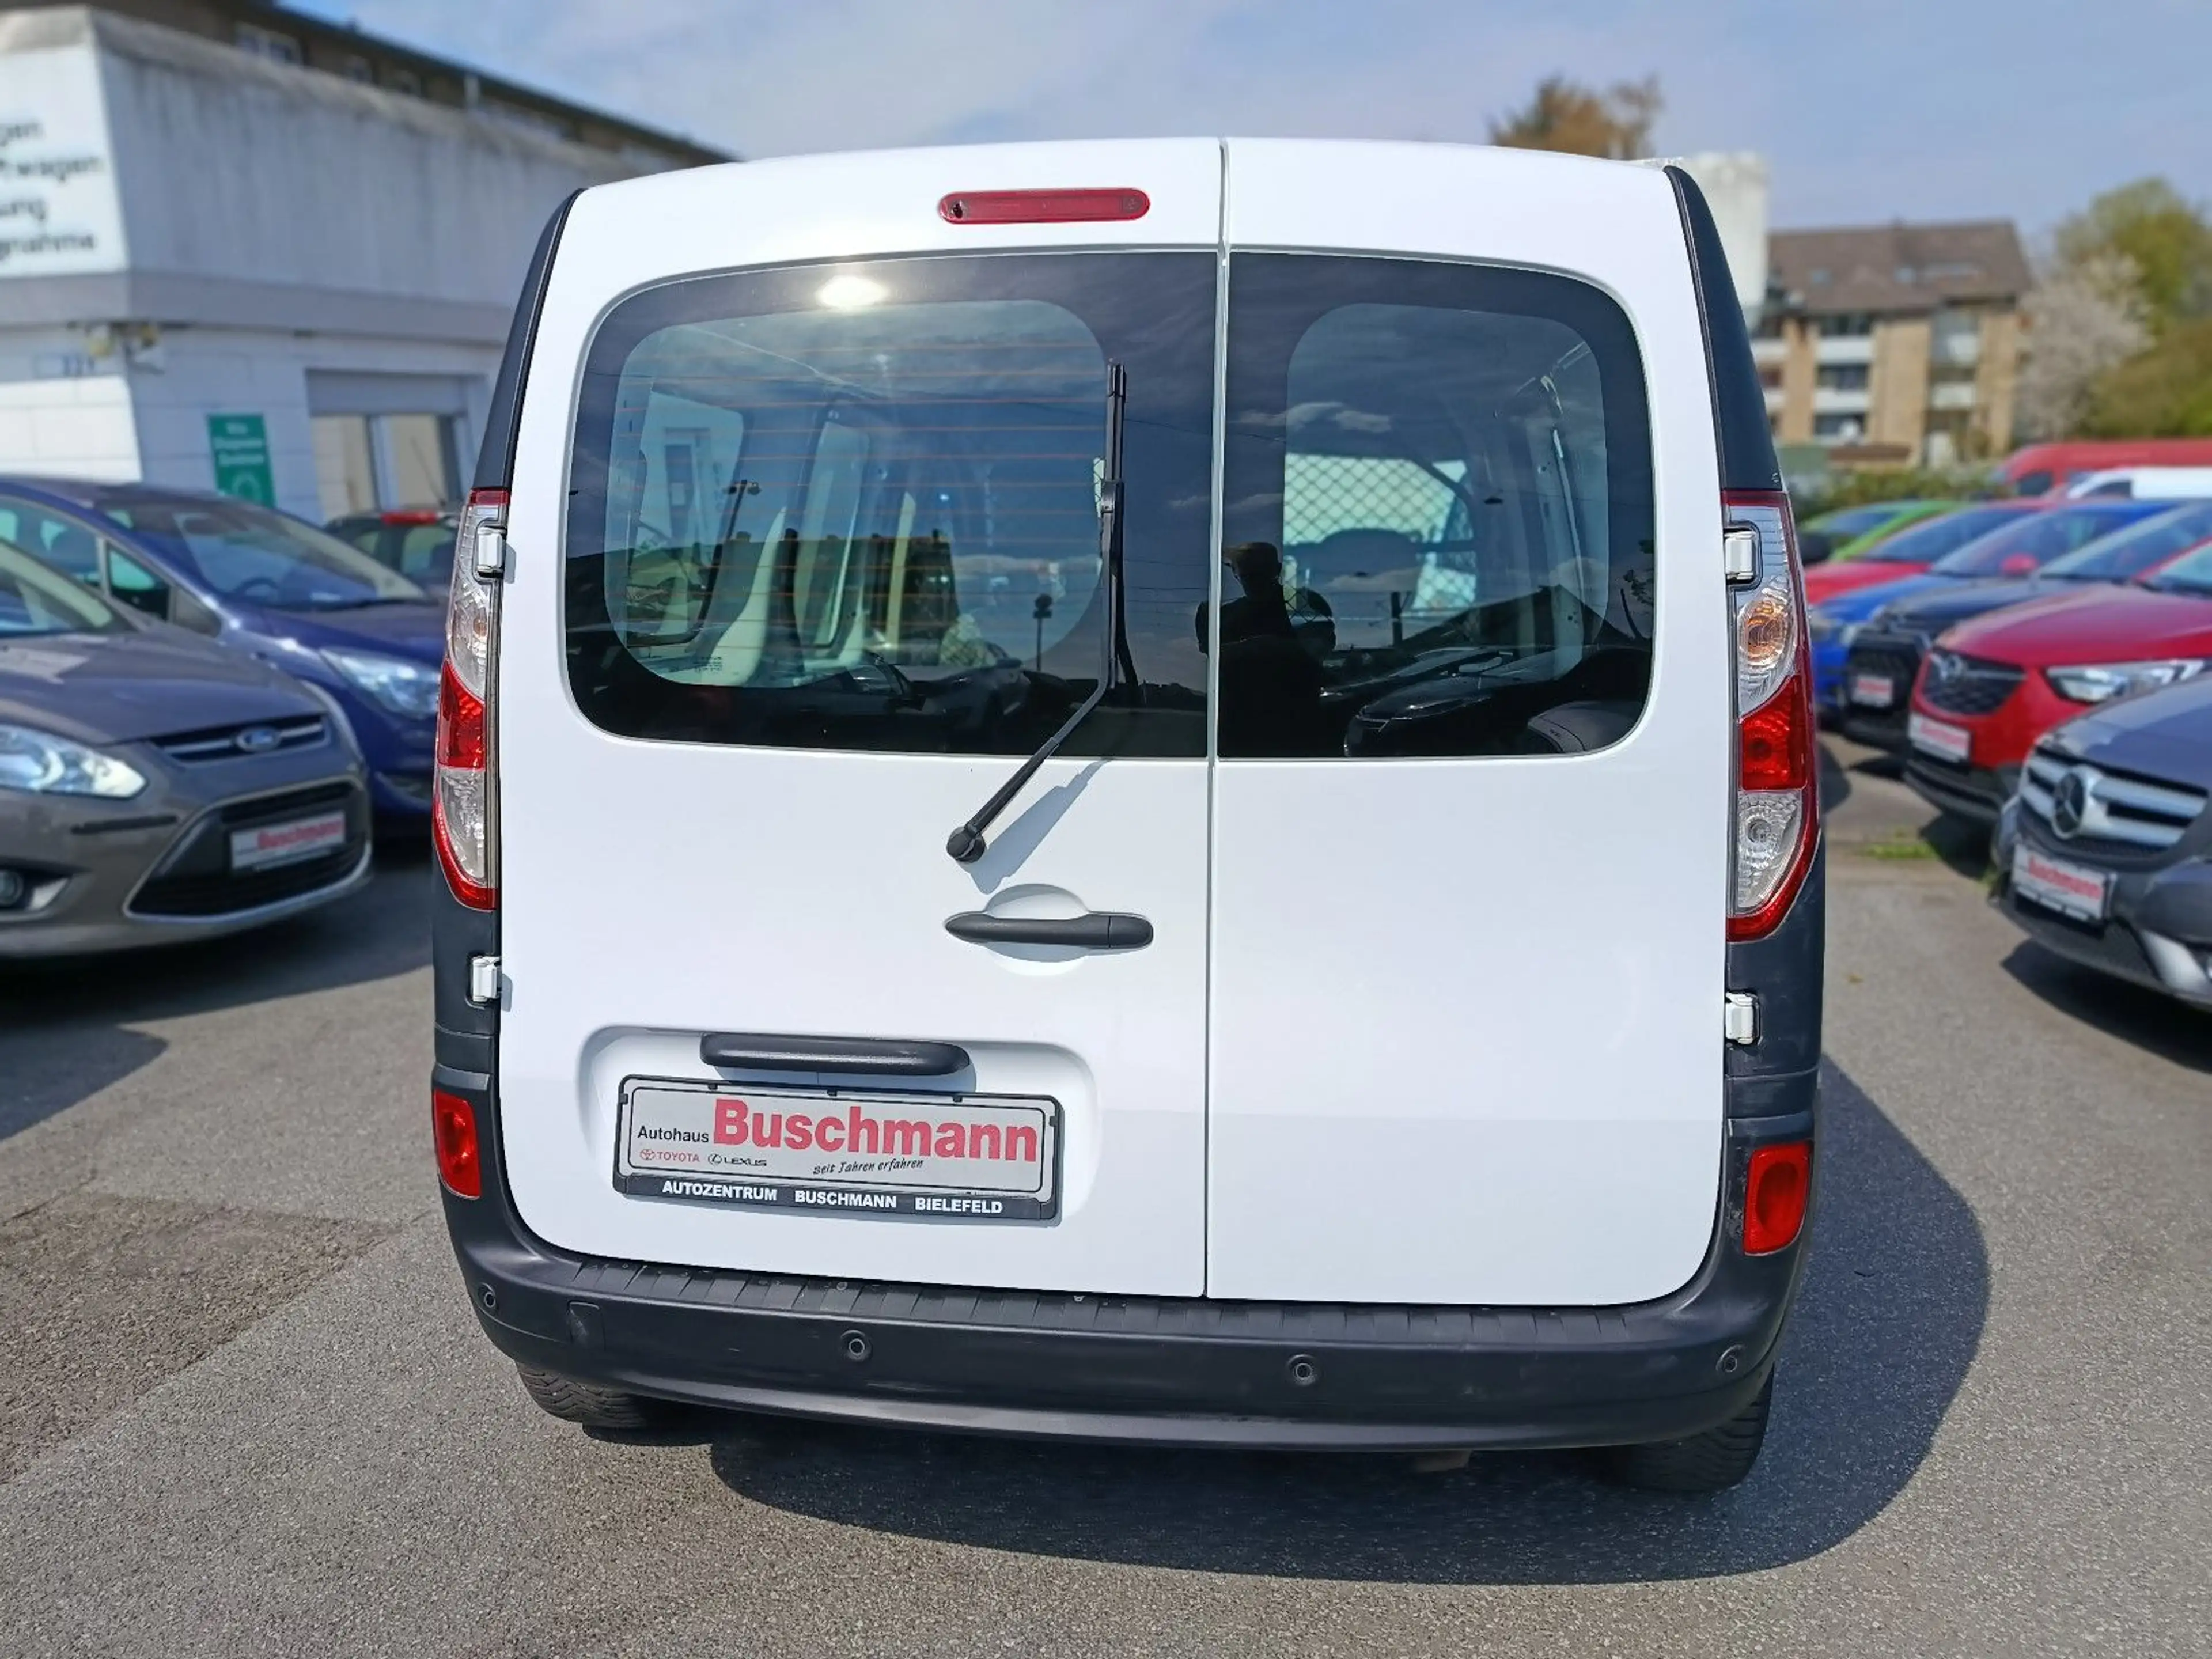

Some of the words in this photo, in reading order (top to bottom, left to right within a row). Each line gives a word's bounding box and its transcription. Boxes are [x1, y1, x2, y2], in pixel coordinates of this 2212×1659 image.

[637, 1125, 709, 1143] Autohaus
[714, 1099, 1036, 1162] Buschmann
[657, 1152, 700, 1162] TOYOTA
[724, 1157, 767, 1166] LEXUS
[838, 1161, 875, 1173] Jahren
[878, 1158, 924, 1171] erfahren
[662, 1180, 777, 1201] AUTOZENTRUM
[794, 1190, 896, 1208] BUSCHMANN
[915, 1198, 1002, 1214] BIELEFELD
